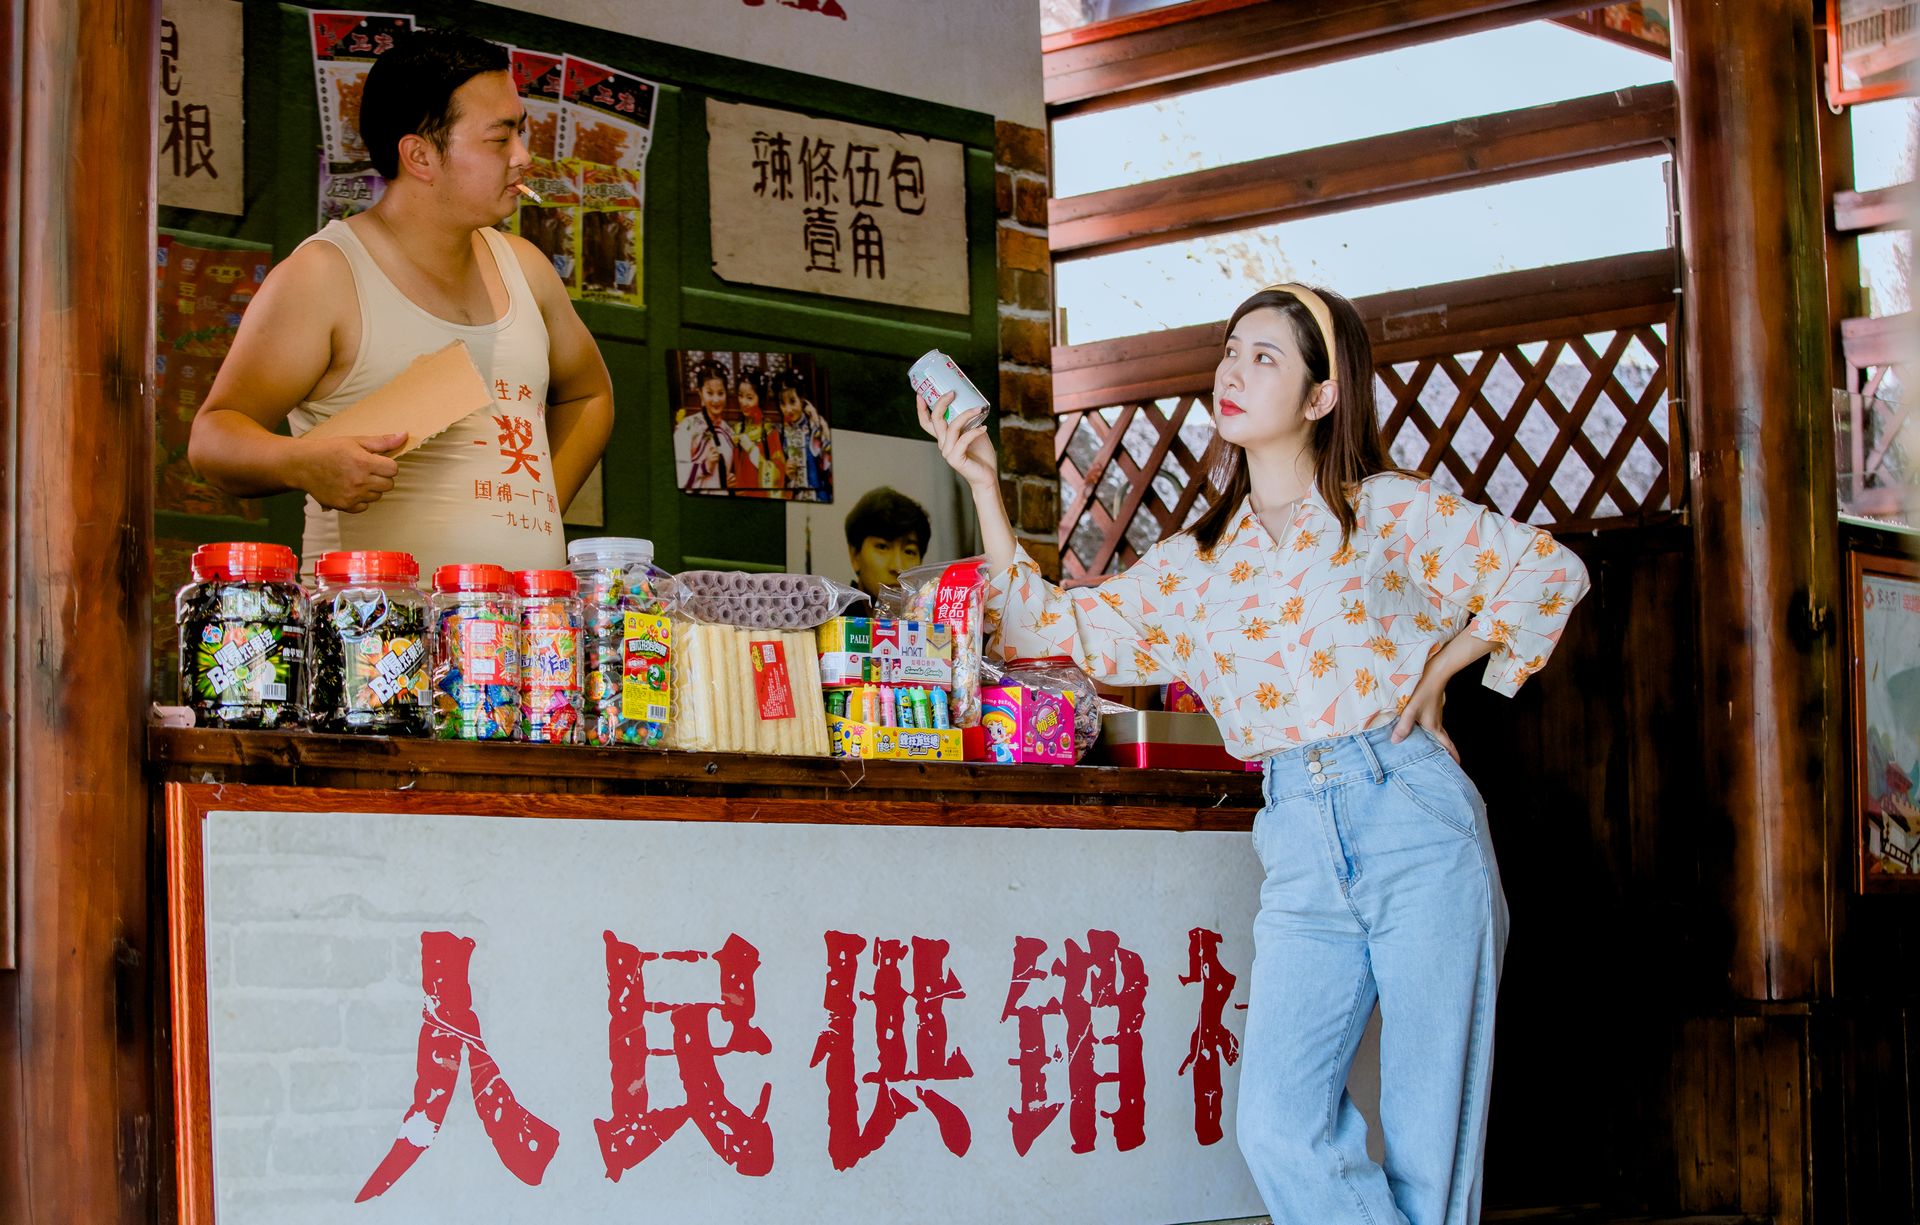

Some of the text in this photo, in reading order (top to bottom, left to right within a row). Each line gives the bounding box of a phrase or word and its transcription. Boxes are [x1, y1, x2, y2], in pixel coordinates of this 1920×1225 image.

[802, 206, 885, 280] 壹角
[492, 511, 553, 535] 一九七八年
[940, 586, 968, 603] 休闲
[937, 602, 964, 619] 食品
[850, 634, 869, 644] PALLY
[1036, 711, 1058, 734] 帅哥
